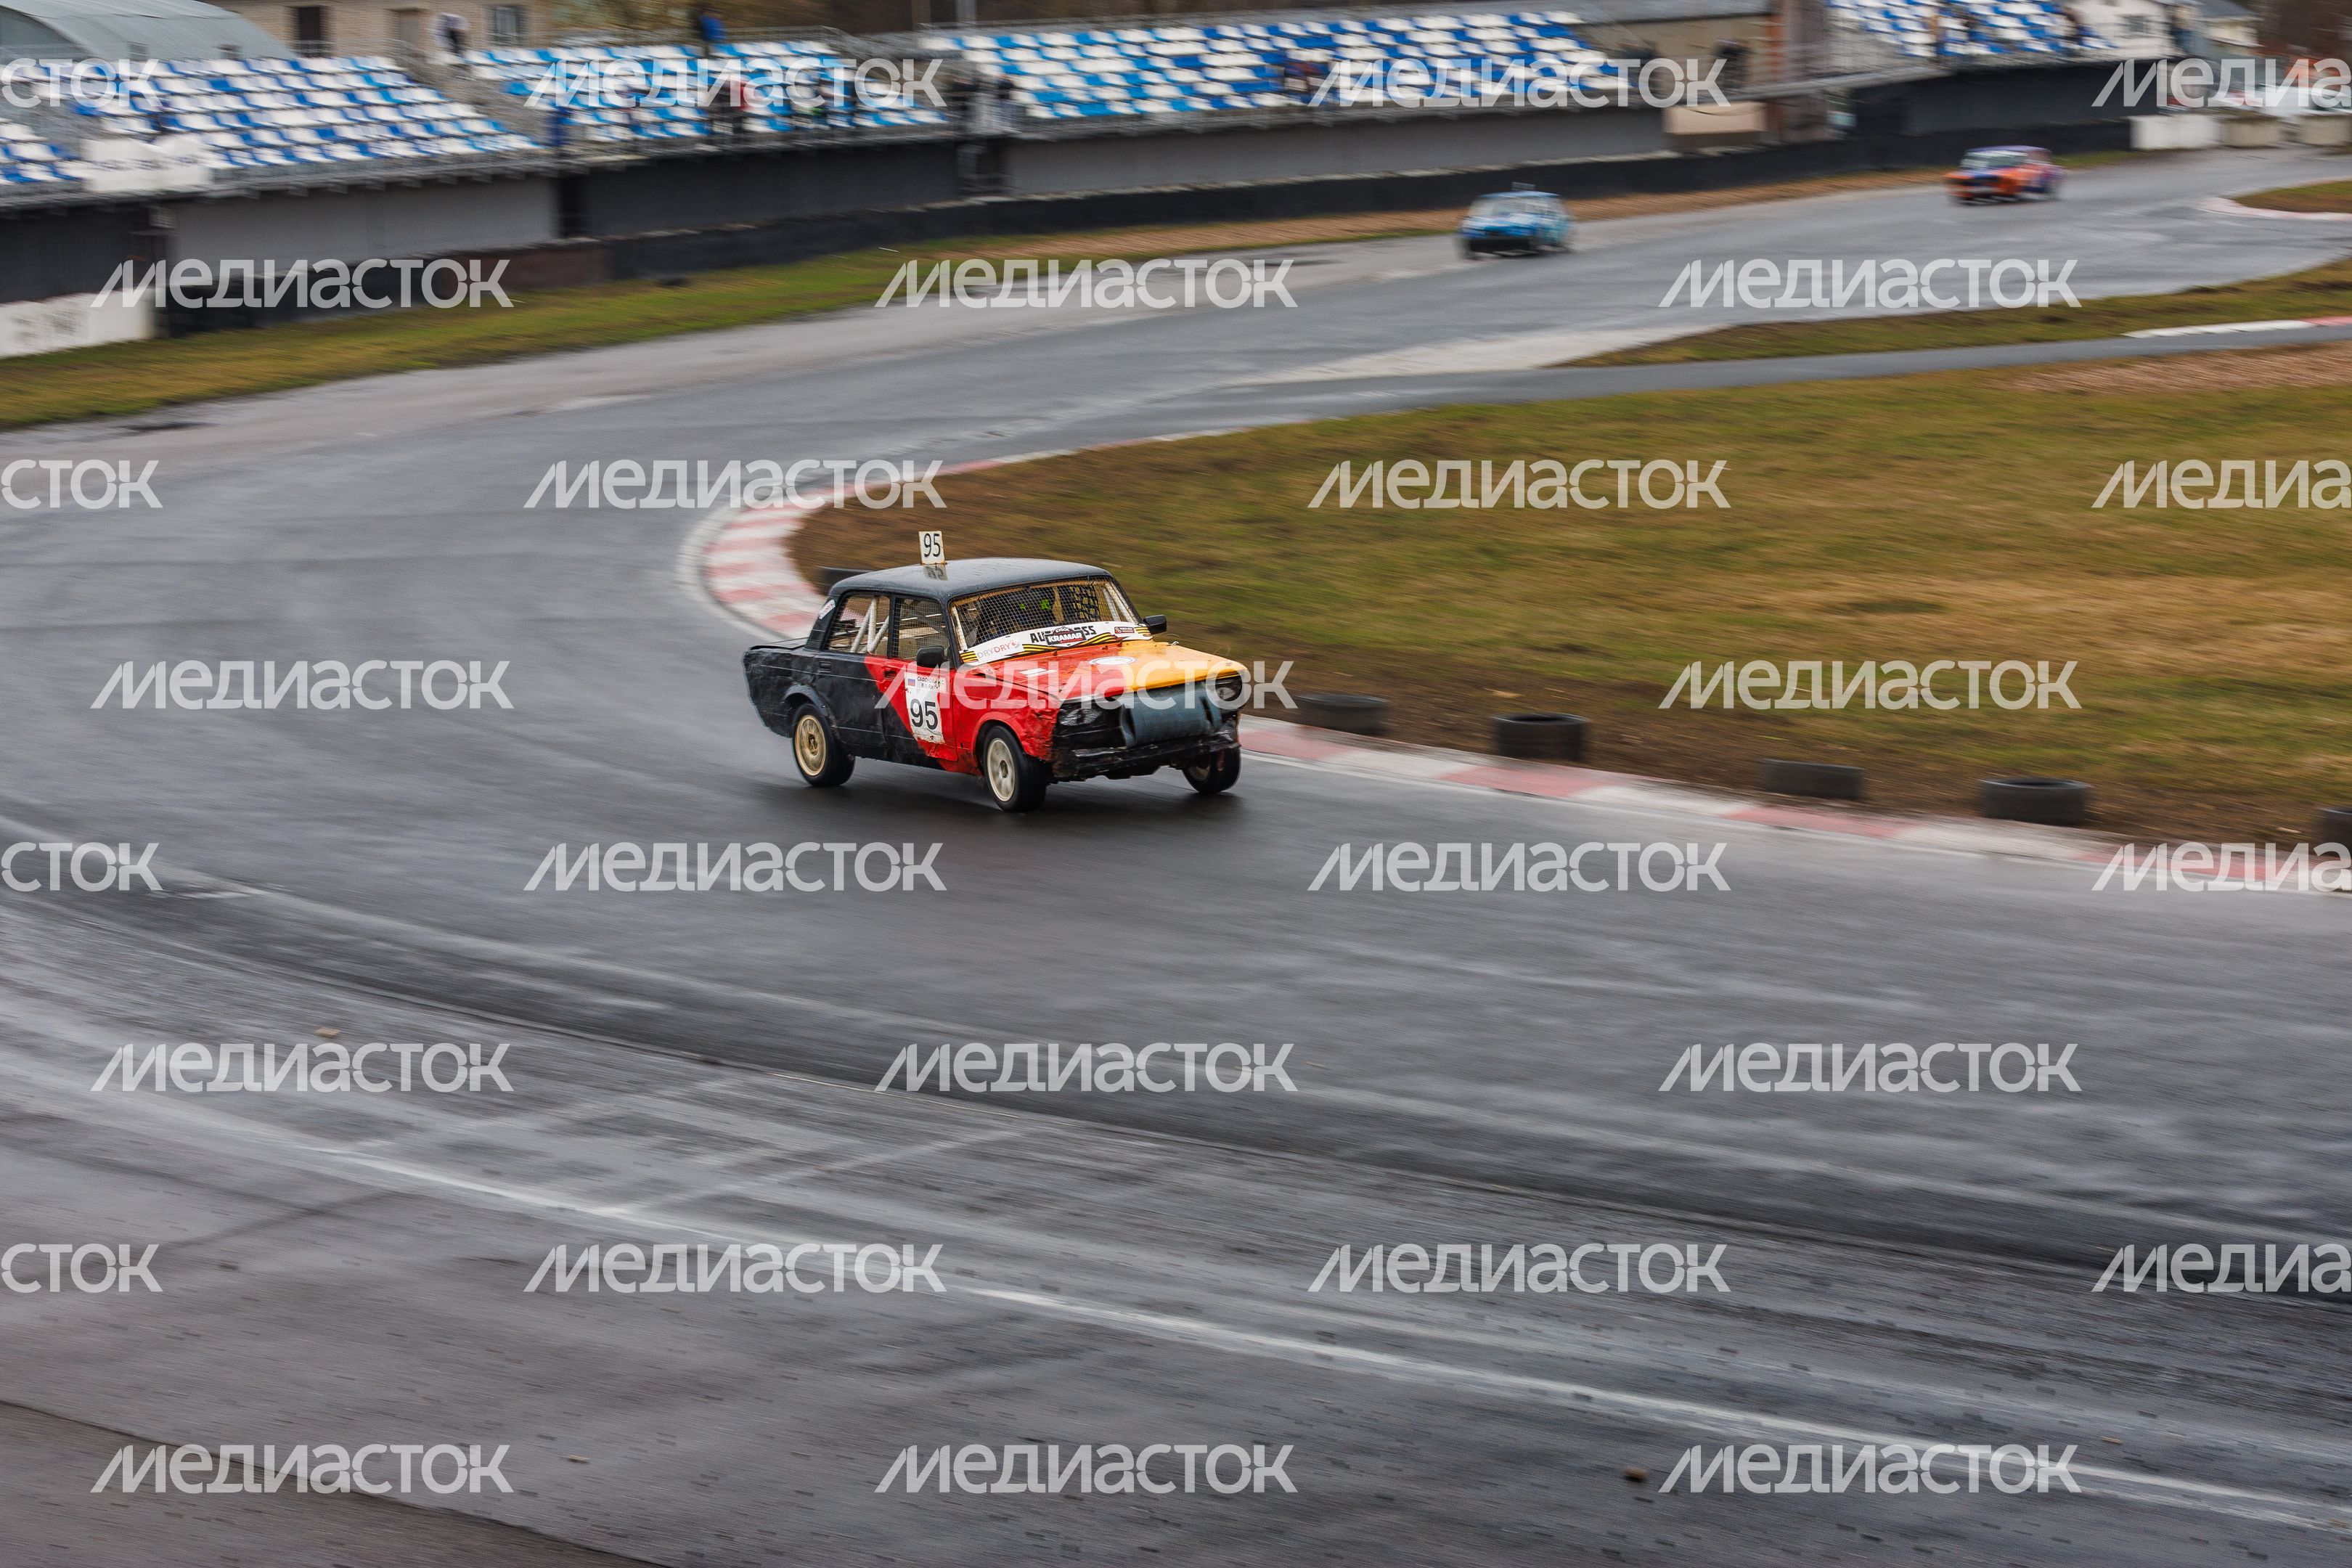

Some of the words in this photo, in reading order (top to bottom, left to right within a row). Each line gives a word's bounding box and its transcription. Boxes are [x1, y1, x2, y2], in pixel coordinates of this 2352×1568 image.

[923, 533, 941, 558] 95
[1048, 632, 1083, 642] KRAMAR
[910, 698, 939, 730] 95
